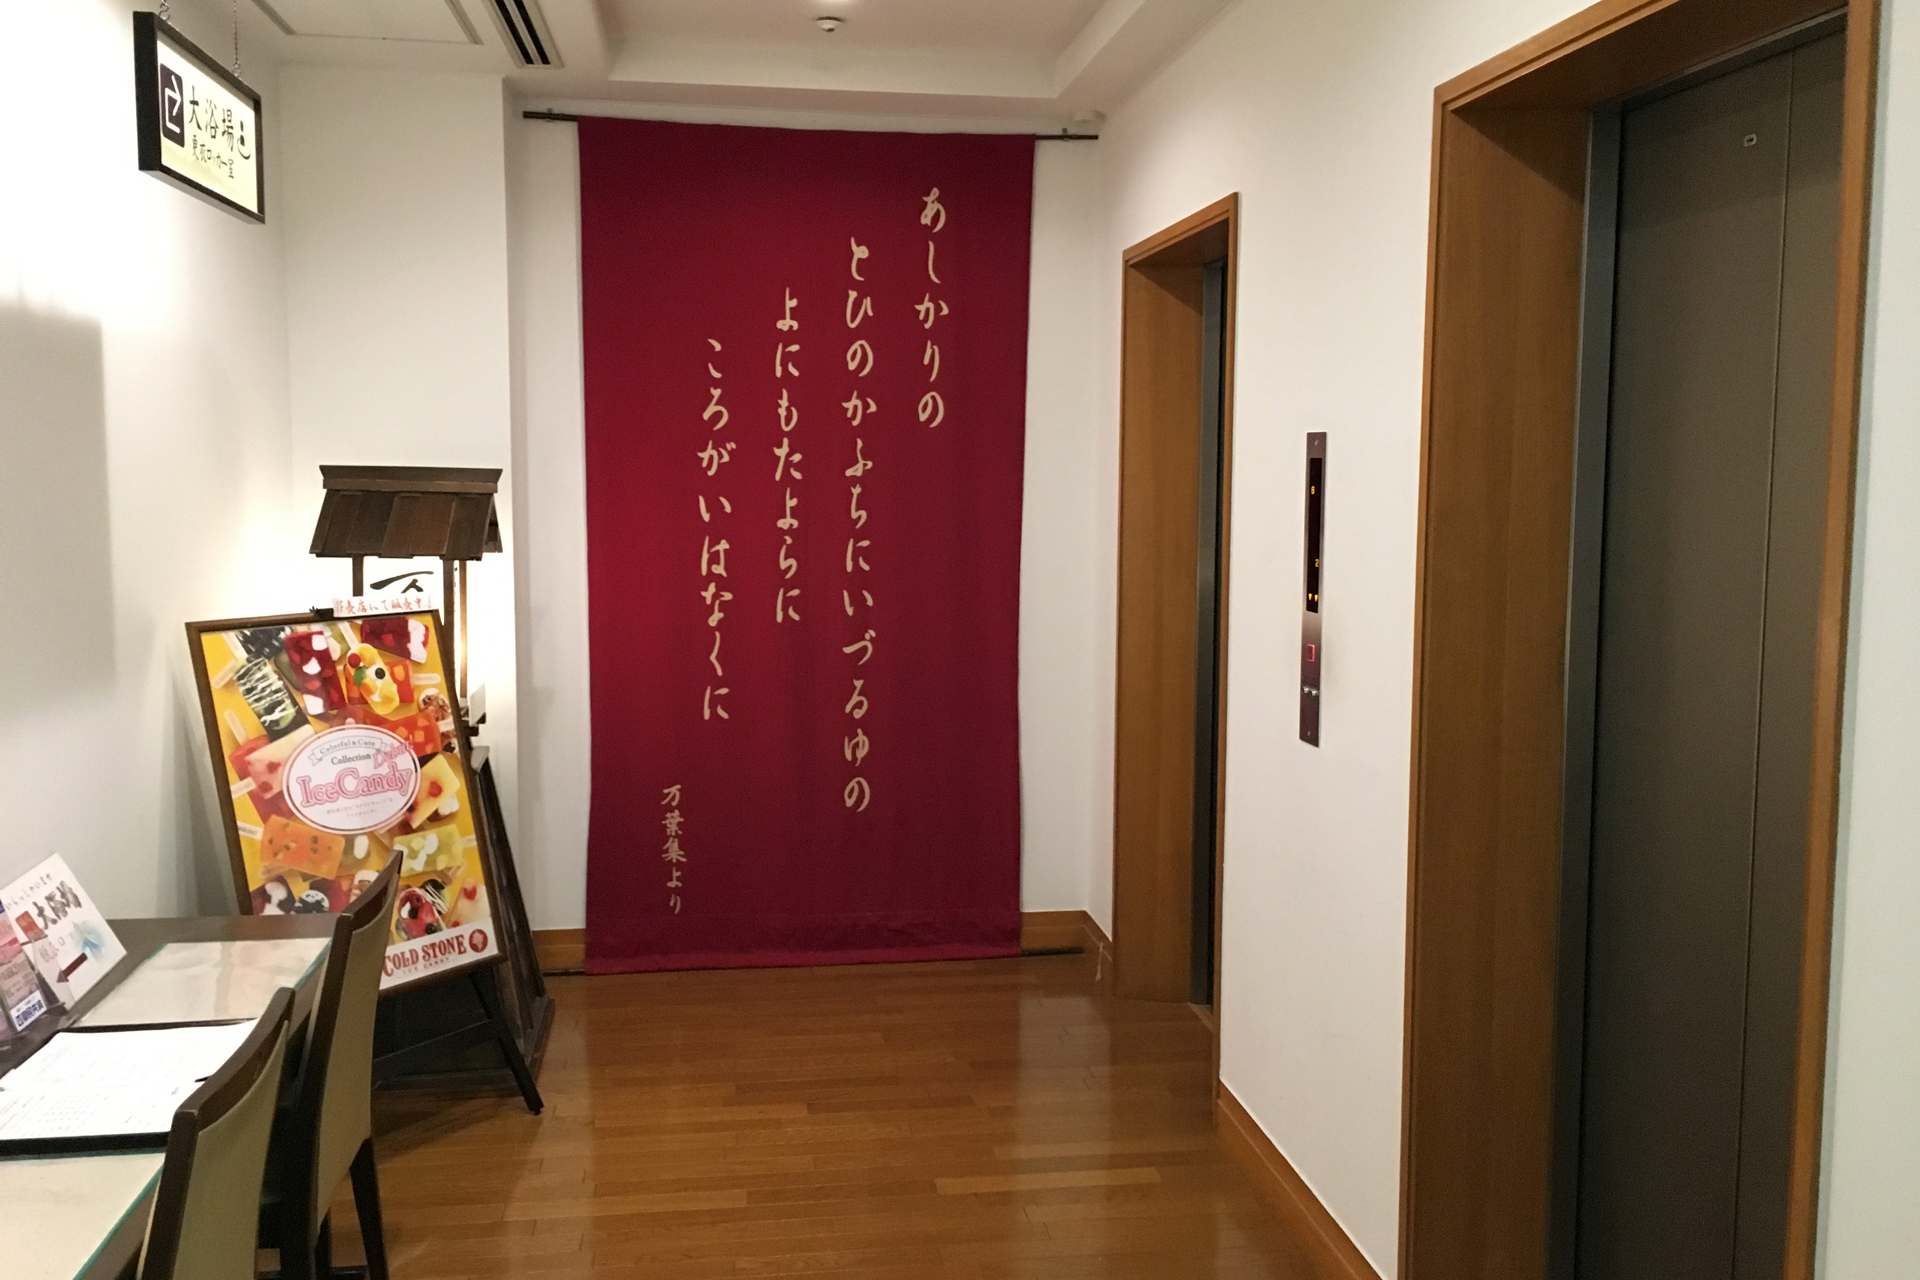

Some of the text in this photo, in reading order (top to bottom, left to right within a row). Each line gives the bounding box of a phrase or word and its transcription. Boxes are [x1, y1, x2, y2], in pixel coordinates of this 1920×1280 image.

[189, 85, 234, 152] 大浴場
[914, 187, 950, 428] あしかりの
[773, 287, 803, 624] よにもたよらに
[697, 339, 736, 720] ころがいはなくに
[842, 237, 877, 812] とひのかふちにいづるゆの
[320, 739, 352, 755] Colorful
[357, 738, 376, 748] Cute
[331, 751, 372, 766] Collection
[660, 784, 687, 915] 万葉集より
[383, 935, 467, 977] COLD STONE
